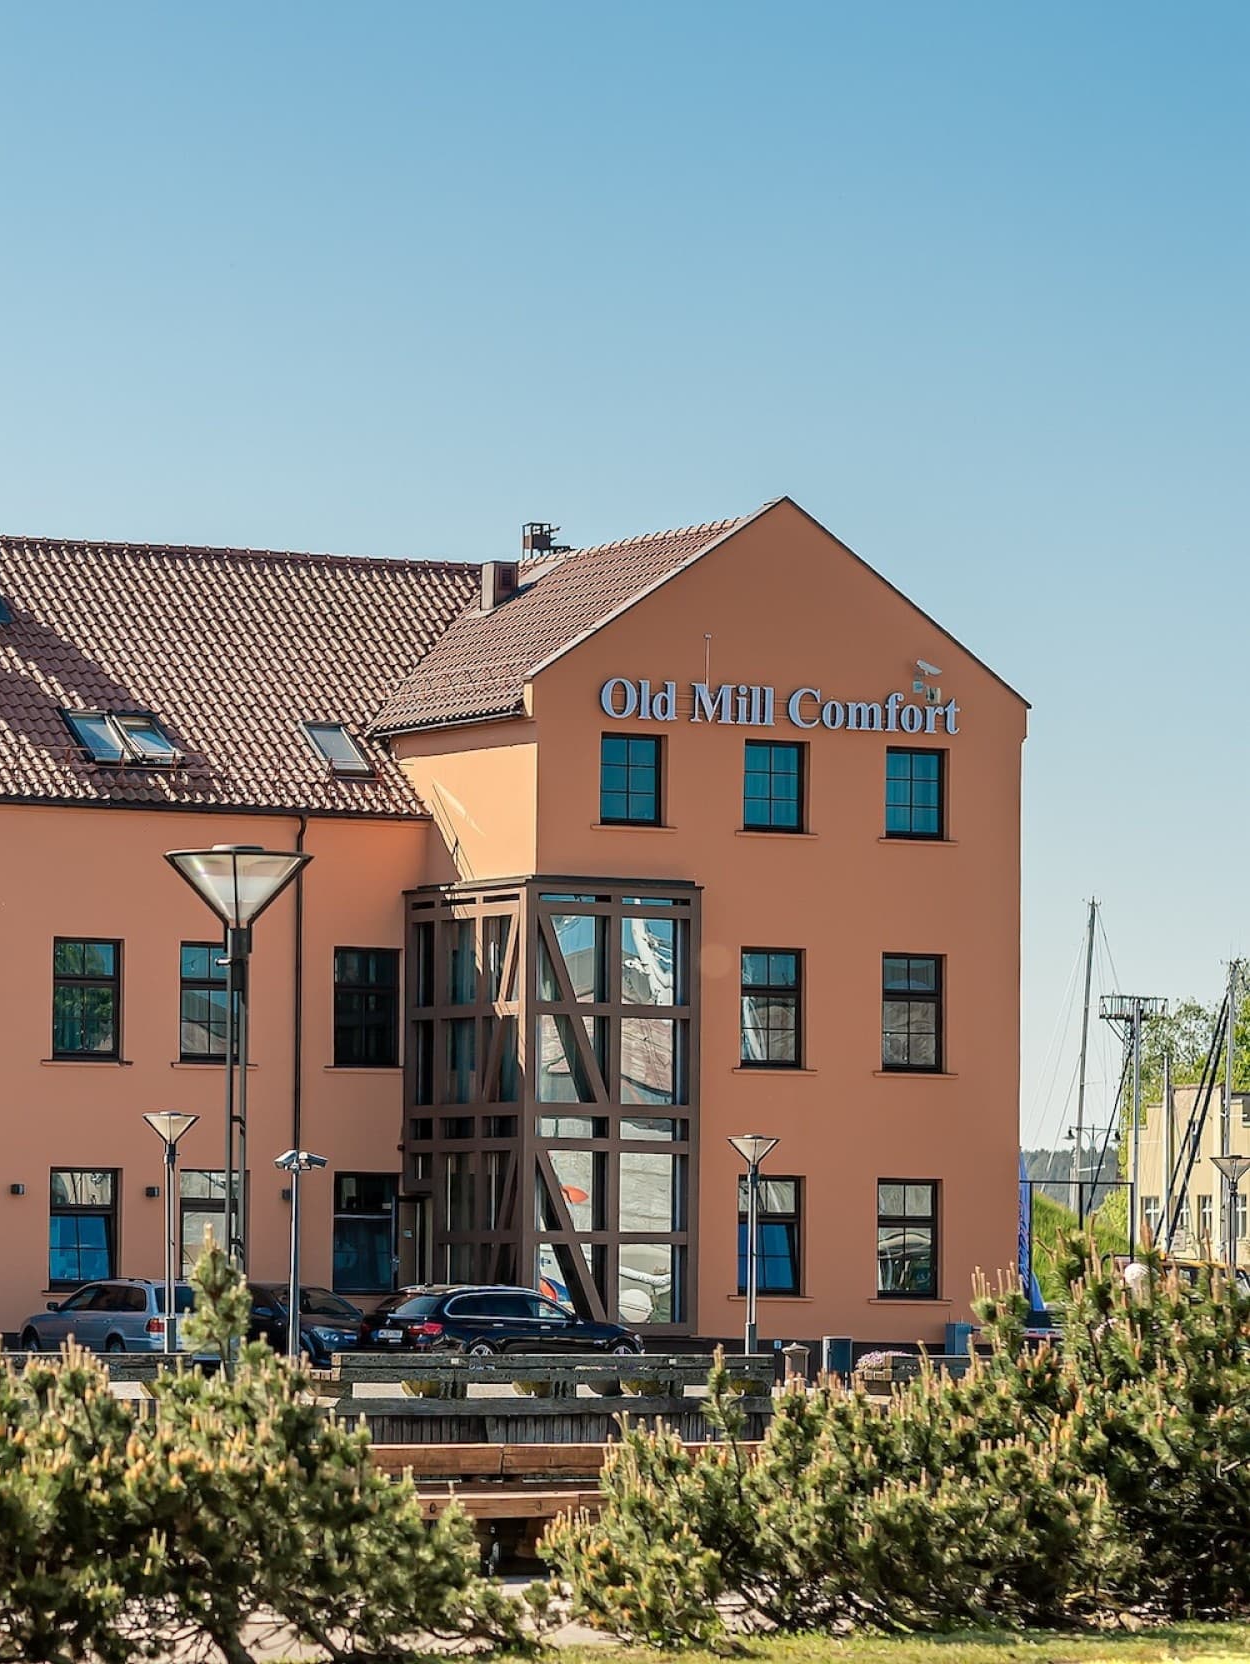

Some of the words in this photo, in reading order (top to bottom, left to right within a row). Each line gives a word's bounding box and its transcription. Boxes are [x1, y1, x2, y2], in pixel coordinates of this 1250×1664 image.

[600, 677, 678, 721] Old
[690, 682, 776, 727] Mill
[787, 687, 961, 735] Comfort
